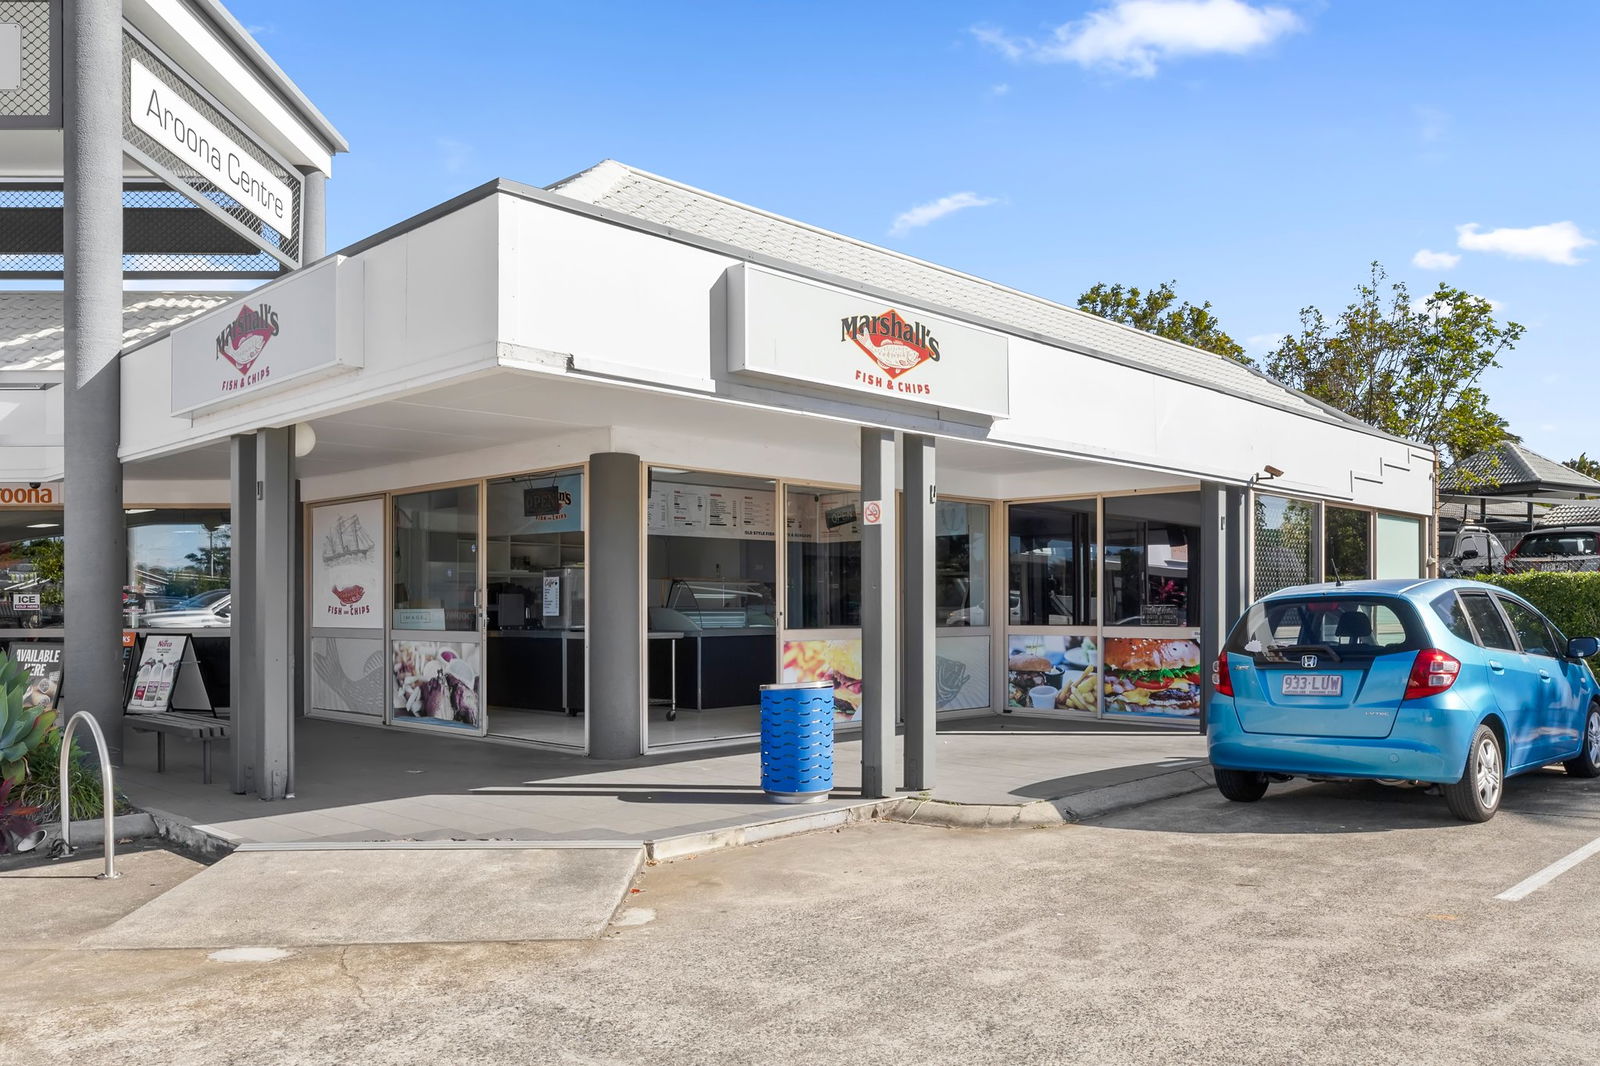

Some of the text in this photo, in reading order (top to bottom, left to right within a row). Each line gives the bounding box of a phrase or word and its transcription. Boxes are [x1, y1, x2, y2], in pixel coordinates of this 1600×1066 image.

[146, 89, 283, 219] Aroona Centre
[215, 303, 280, 361] Marshall's
[840, 312, 941, 363] Marshall's
[221, 380, 239, 392] FISH
[247, 365, 270, 386] CHIPS
[855, 369, 931, 395] FISH & CHIPS
[0, 487, 53, 504] oona
[18, 595, 36, 604] ICE
[327, 605, 342, 616] FISH
[350, 604, 370, 616] CHIPS
